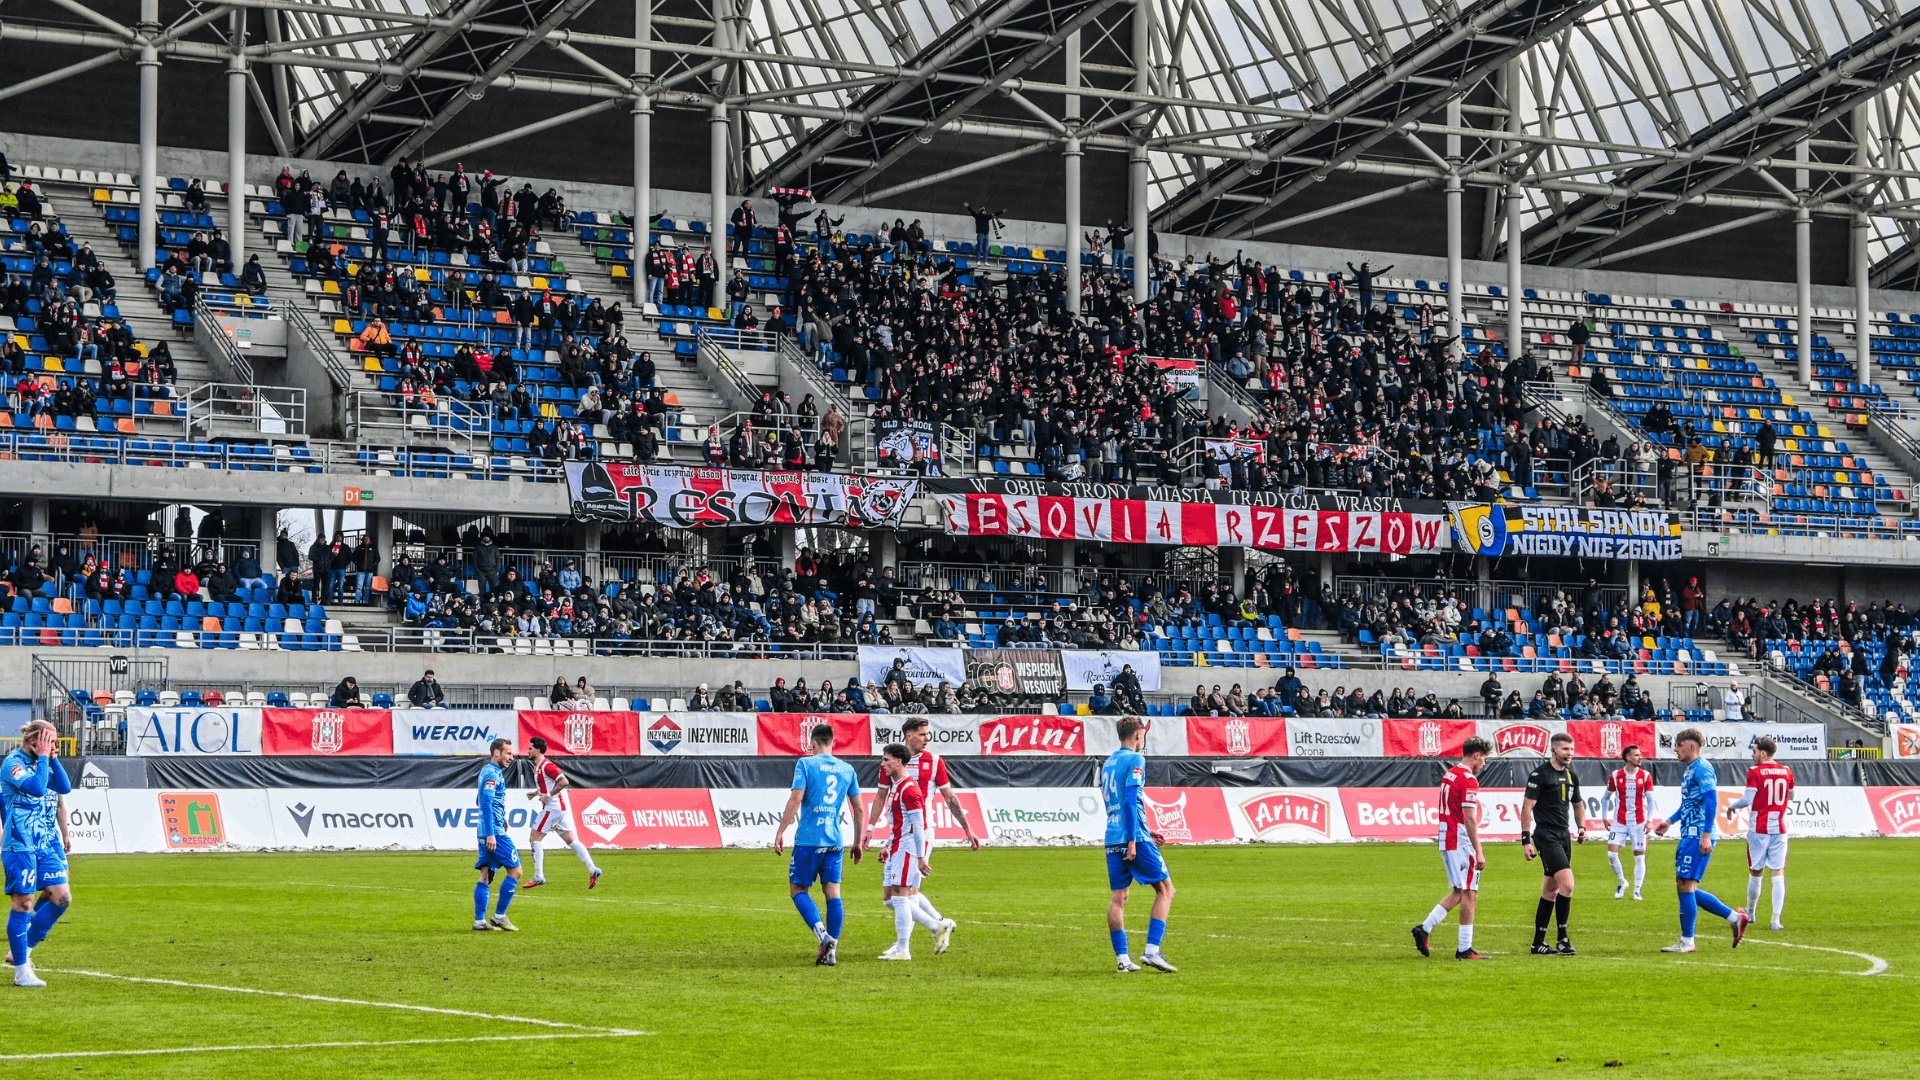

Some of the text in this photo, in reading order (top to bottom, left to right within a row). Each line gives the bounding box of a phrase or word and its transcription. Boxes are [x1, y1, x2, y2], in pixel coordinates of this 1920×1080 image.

[345, 490, 359, 501] D1
[969, 478, 1403, 513] W OBIE STRONY MIASTA TRADYCJA WRASTA
[1521, 507, 1671, 537] STAL SANOK
[1511, 534, 1682, 560] NIGDY NIE ZGINIE
[1708, 543, 1719, 555] G1
[110, 658, 128, 673] VIP
[1015, 662, 1062, 677] WSPIERAJ
[1023, 680, 1061, 697] RESOVIĘ
[1696, 684, 1708, 695] VIP
[136, 711, 252, 753] ATOL
[983, 718, 1081, 755] Arini
[1294, 732, 1361, 745] Lift Rzeszów
[1501, 728, 1544, 750] Arini
[1295, 745, 1325, 756] Orona
[823, 774, 838, 805] 3
[1439, 782, 1451, 815] 11
[1763, 778, 1788, 806] 10
[322, 812, 414, 828] macron
[987, 808, 1080, 823] Lift Rzeszów
[1255, 797, 1319, 828] Arini
[1357, 802, 1439, 825] Betclic
[21, 868, 36, 887] 14
